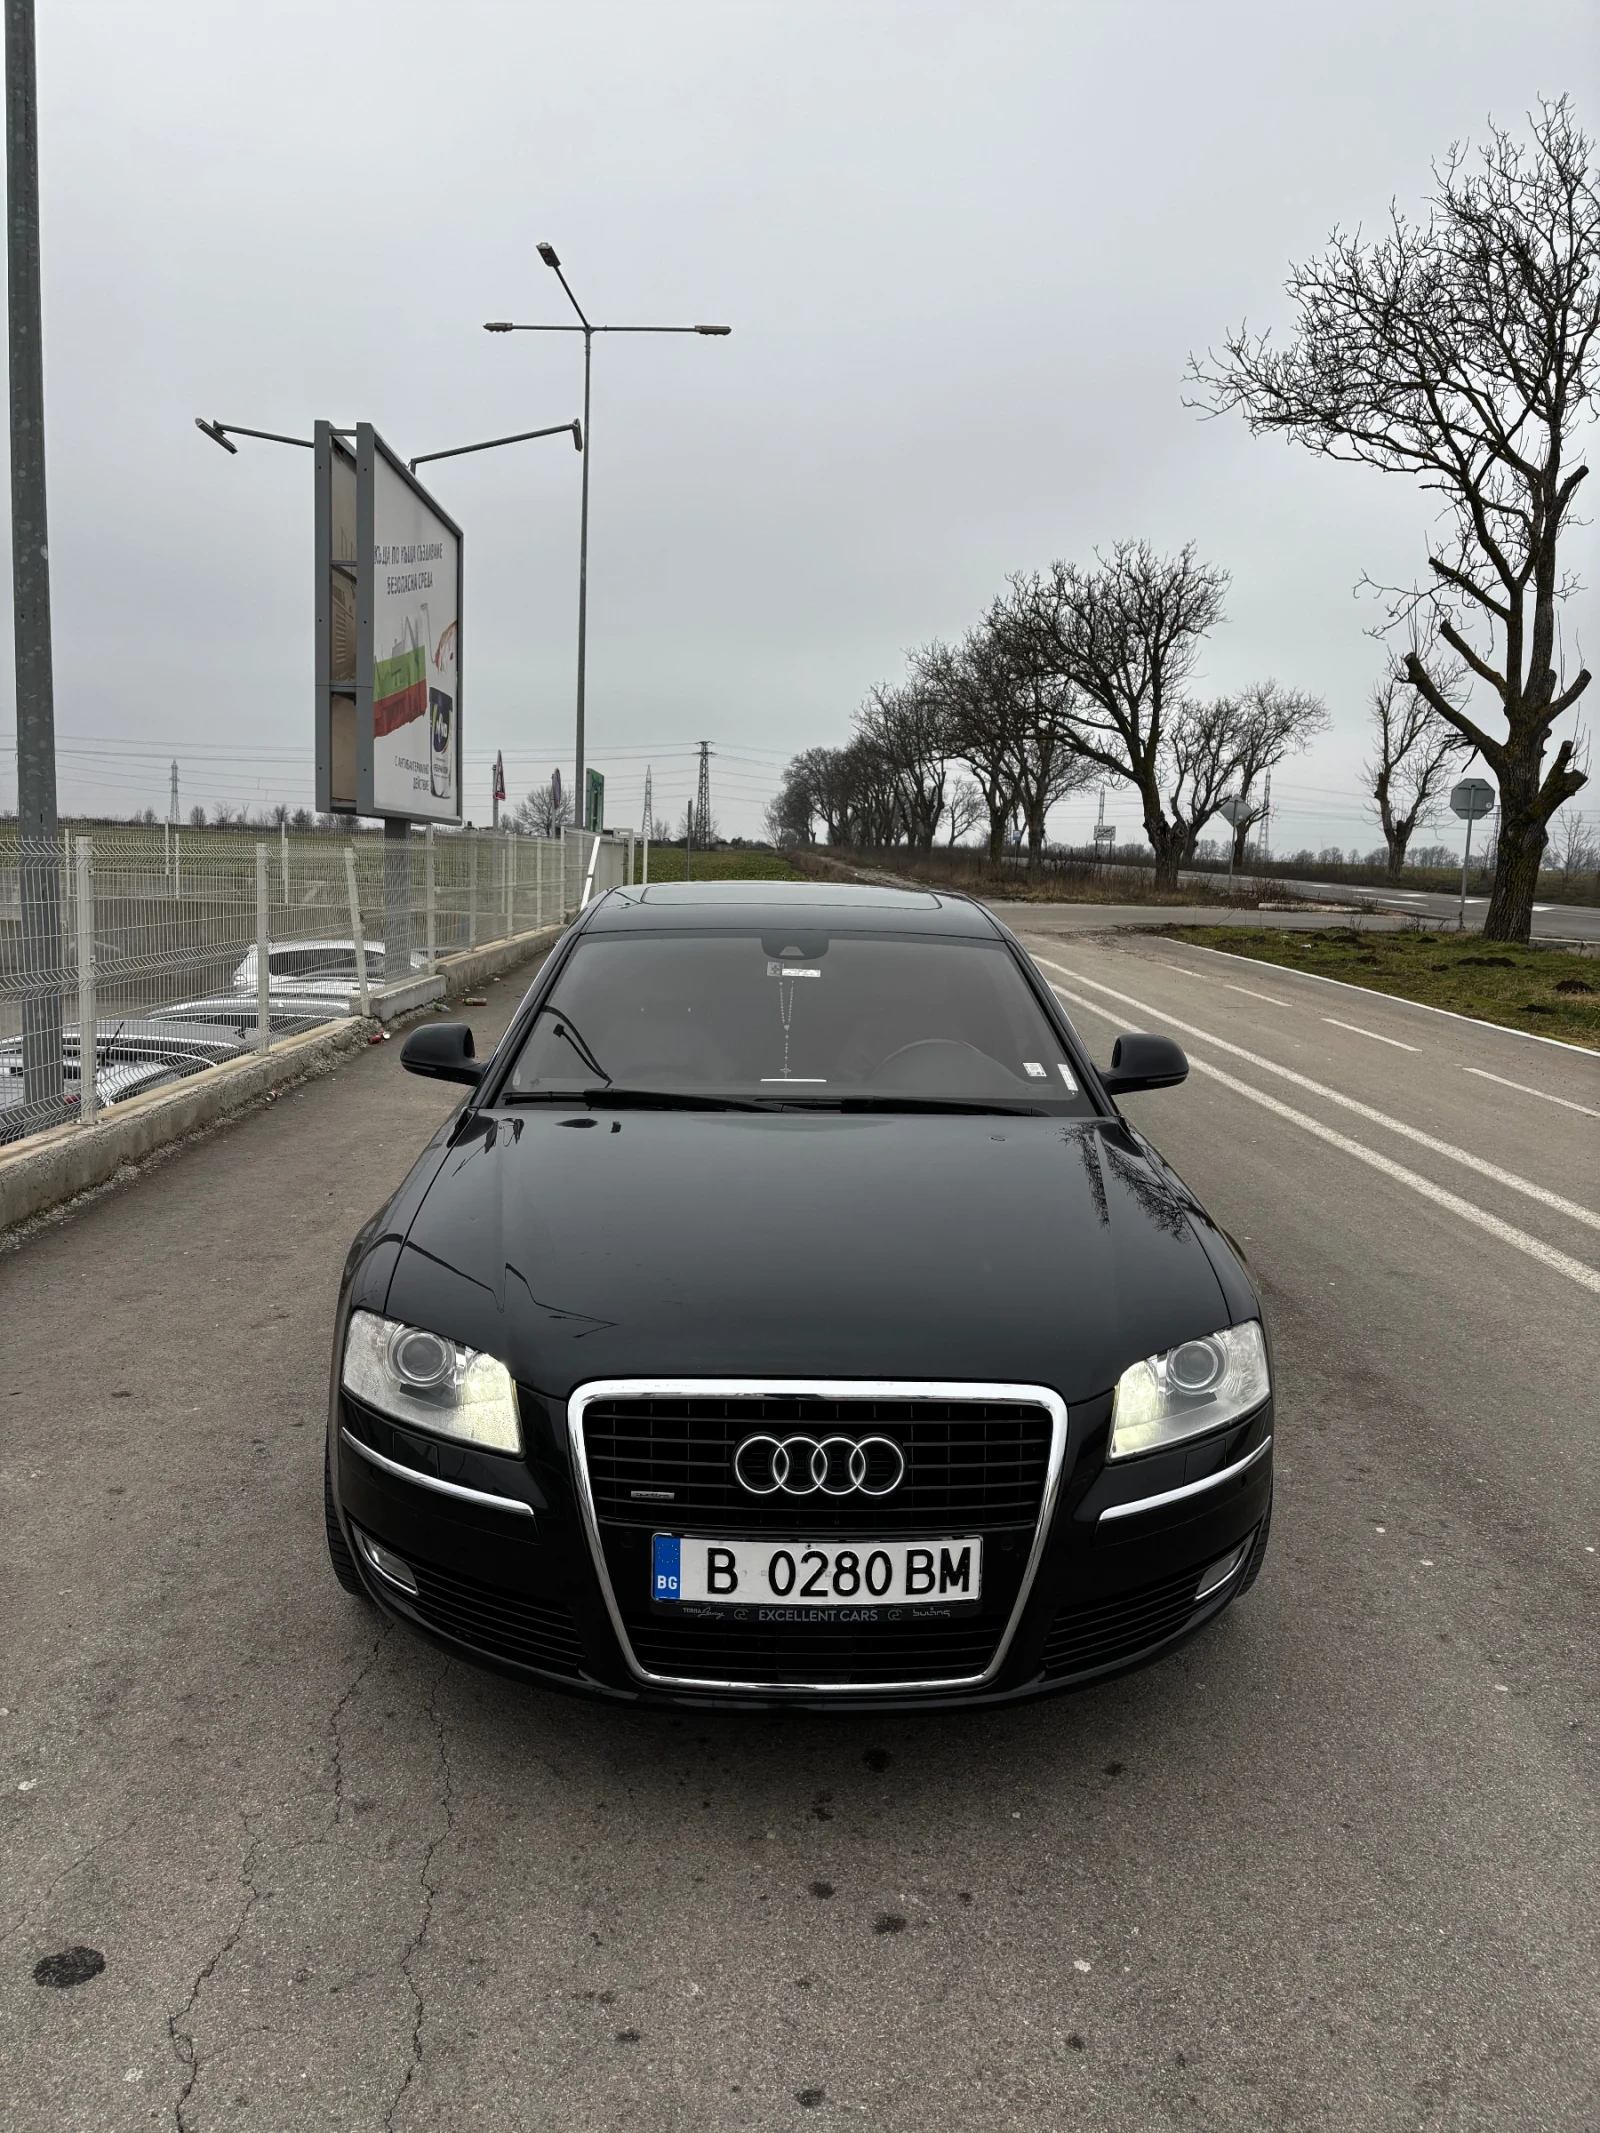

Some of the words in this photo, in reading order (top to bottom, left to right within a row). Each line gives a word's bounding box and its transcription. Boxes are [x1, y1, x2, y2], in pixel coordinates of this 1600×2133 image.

[387, 573, 417, 595] БЕЗОПАСНА
[418, 571, 433, 589] СРЕДА
[706, 1547, 738, 1595] B
[768, 1549, 893, 1597] 0280
[905, 1547, 971, 1596] BM
[657, 1576, 678, 1590] BG
[758, 1609, 837, 1622] EXCELLENT
[839, 1610, 878, 1622] CARS
